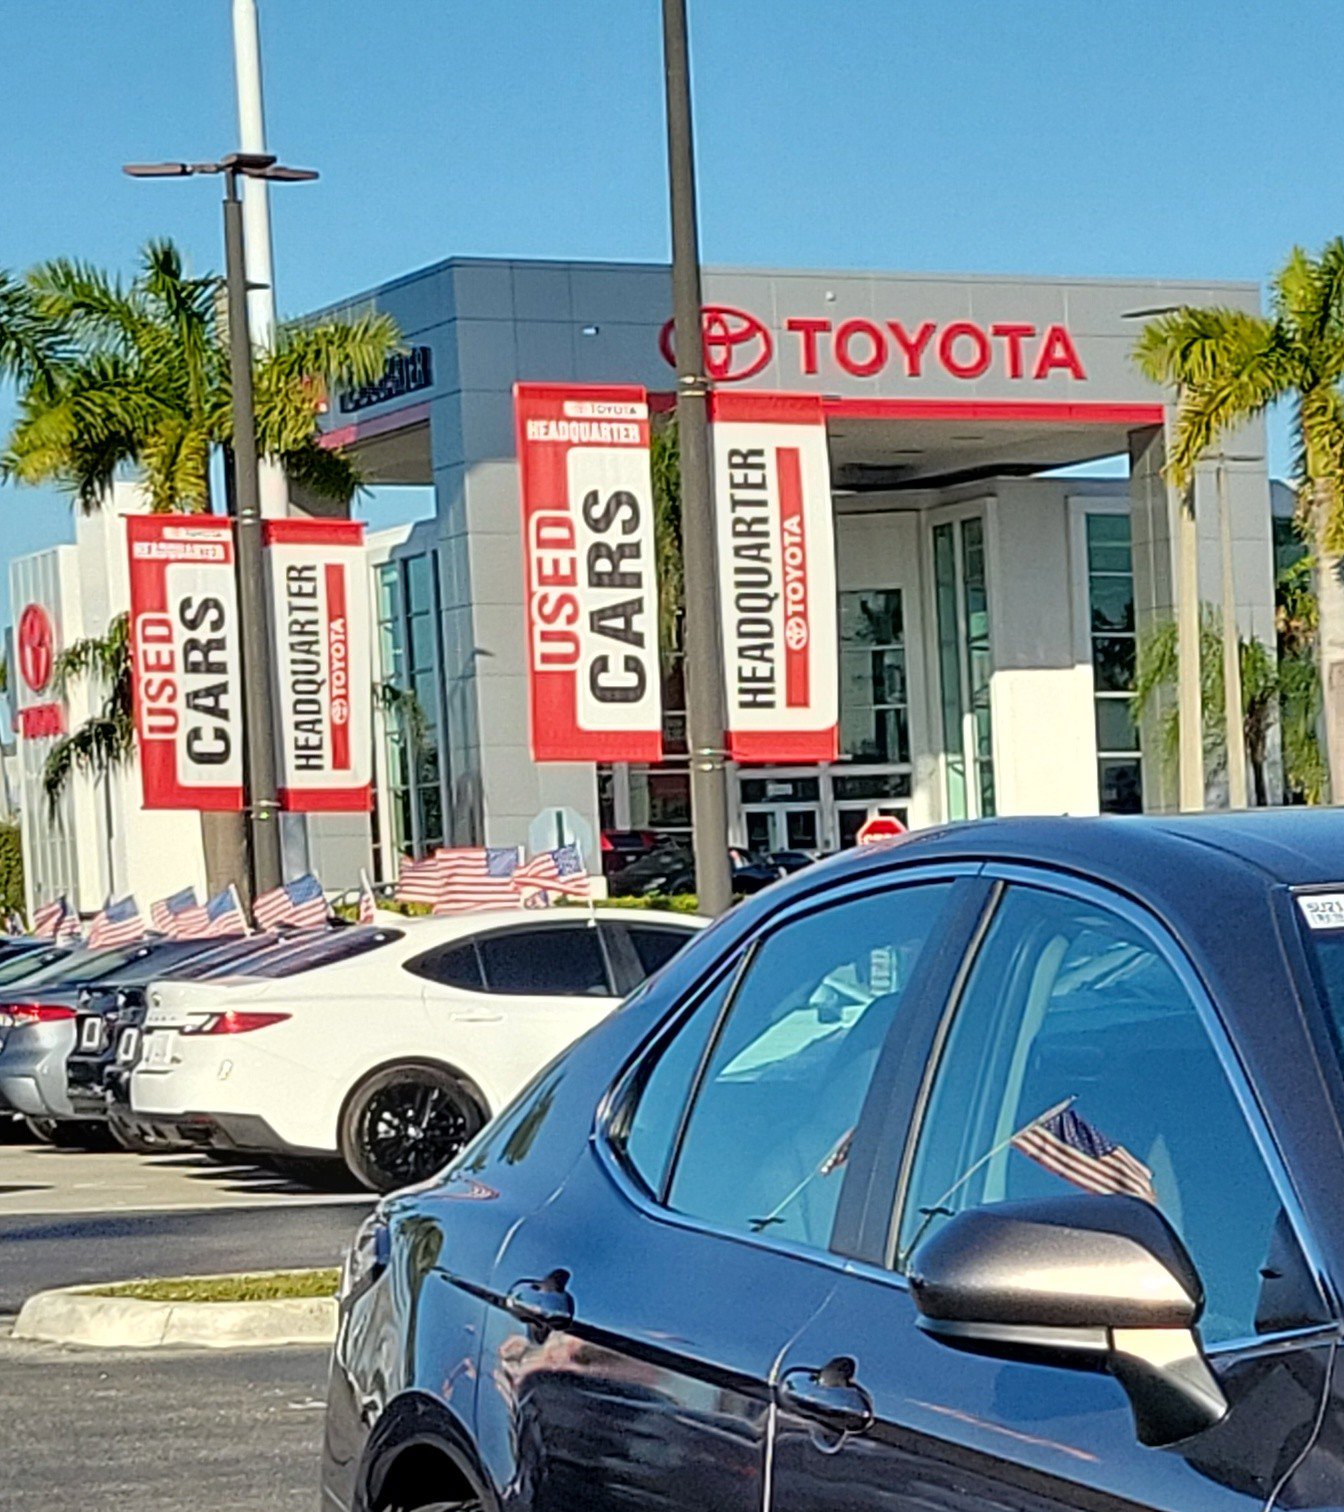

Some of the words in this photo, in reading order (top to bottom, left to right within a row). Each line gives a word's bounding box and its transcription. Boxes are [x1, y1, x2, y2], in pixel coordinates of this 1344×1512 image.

[786, 317, 1088, 380] TOYOTA
[534, 516, 582, 665] USED
[581, 489, 647, 703] CARS
[728, 447, 779, 709] HEADQUARTER
[782, 515, 806, 617] TOYOTA
[141, 618, 178, 736] USED
[178, 596, 232, 765] CARS
[285, 563, 327, 771] HEADQUARTER
[329, 617, 349, 698] TOYOTA
